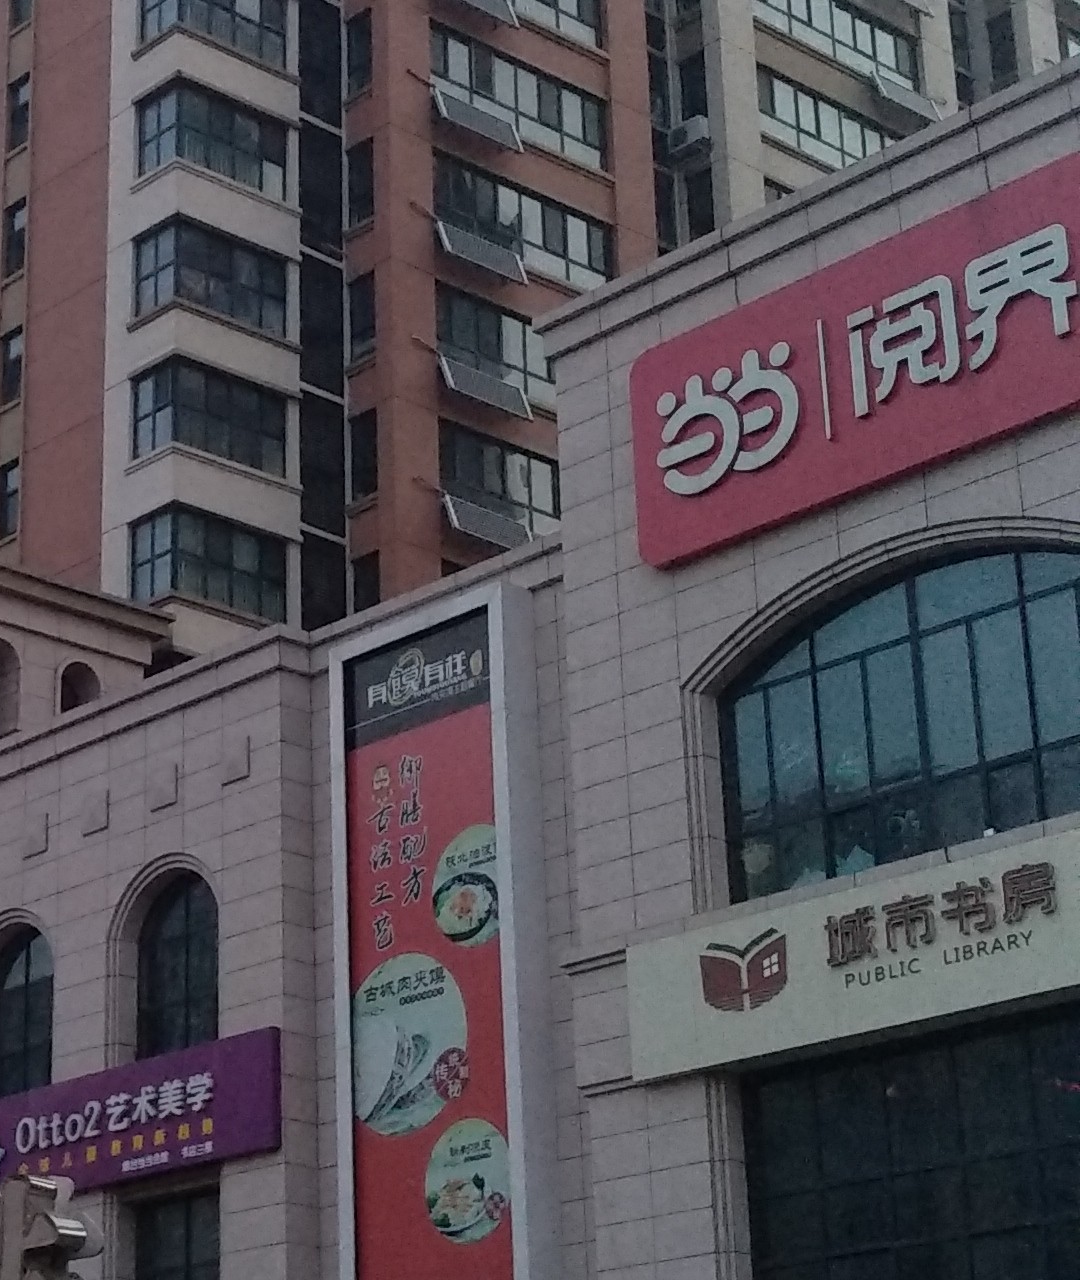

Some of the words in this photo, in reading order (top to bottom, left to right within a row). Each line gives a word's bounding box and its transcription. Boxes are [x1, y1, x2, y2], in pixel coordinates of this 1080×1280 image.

[846, 223, 1079, 418] 阅界
[825, 862, 1058, 968] 城市书房
[845, 957, 922, 989] PUBLIC
[943, 930, 1033, 965] LIBRARY
